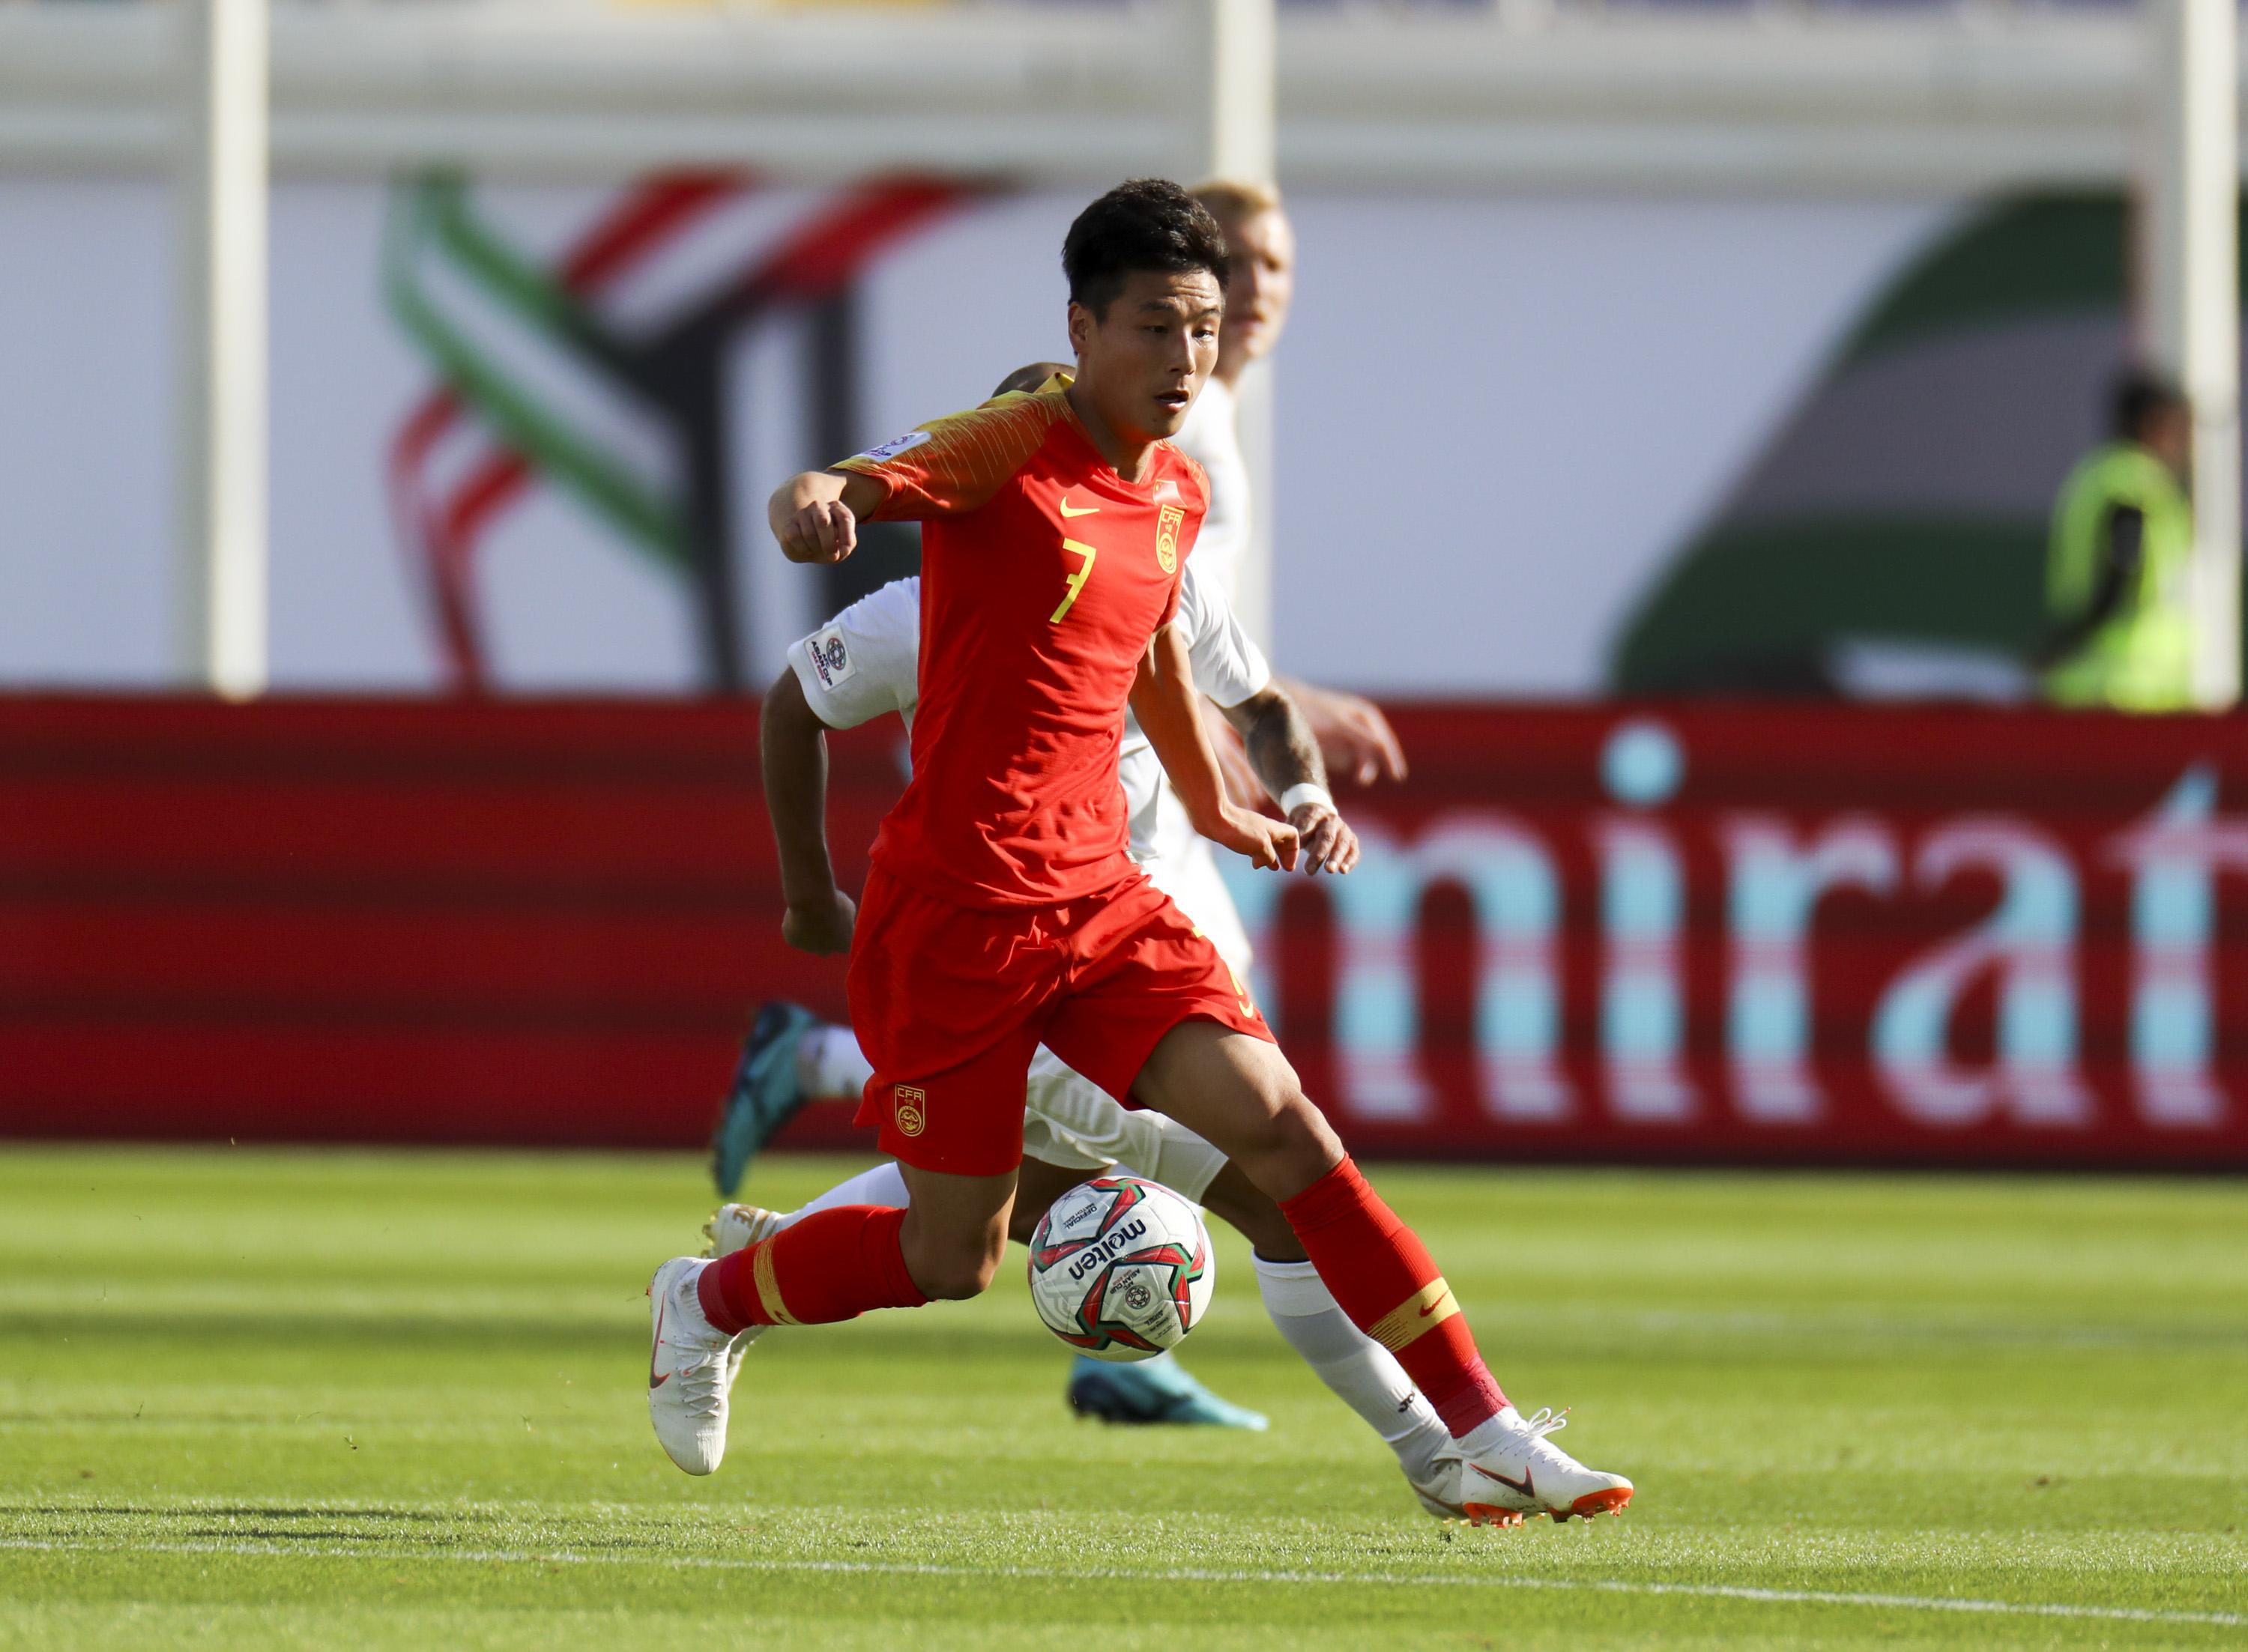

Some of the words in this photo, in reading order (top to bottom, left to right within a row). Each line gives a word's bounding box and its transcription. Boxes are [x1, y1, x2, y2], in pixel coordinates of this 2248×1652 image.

[1161, 509, 1182, 526] CFA
[1049, 537, 1096, 623] 7
[812, 641, 825, 667] ASIAN
[824, 668, 833, 686] CUP
[1215, 721, 2248, 1126] mirat
[897, 1087, 922, 1101] CFA
[1064, 1206, 1097, 1229] OFFICIAL
[1068, 1218, 1146, 1280] molten
[1110, 1283, 1123, 1294] CUP
[1123, 1268, 1140, 1286] ASIAN
